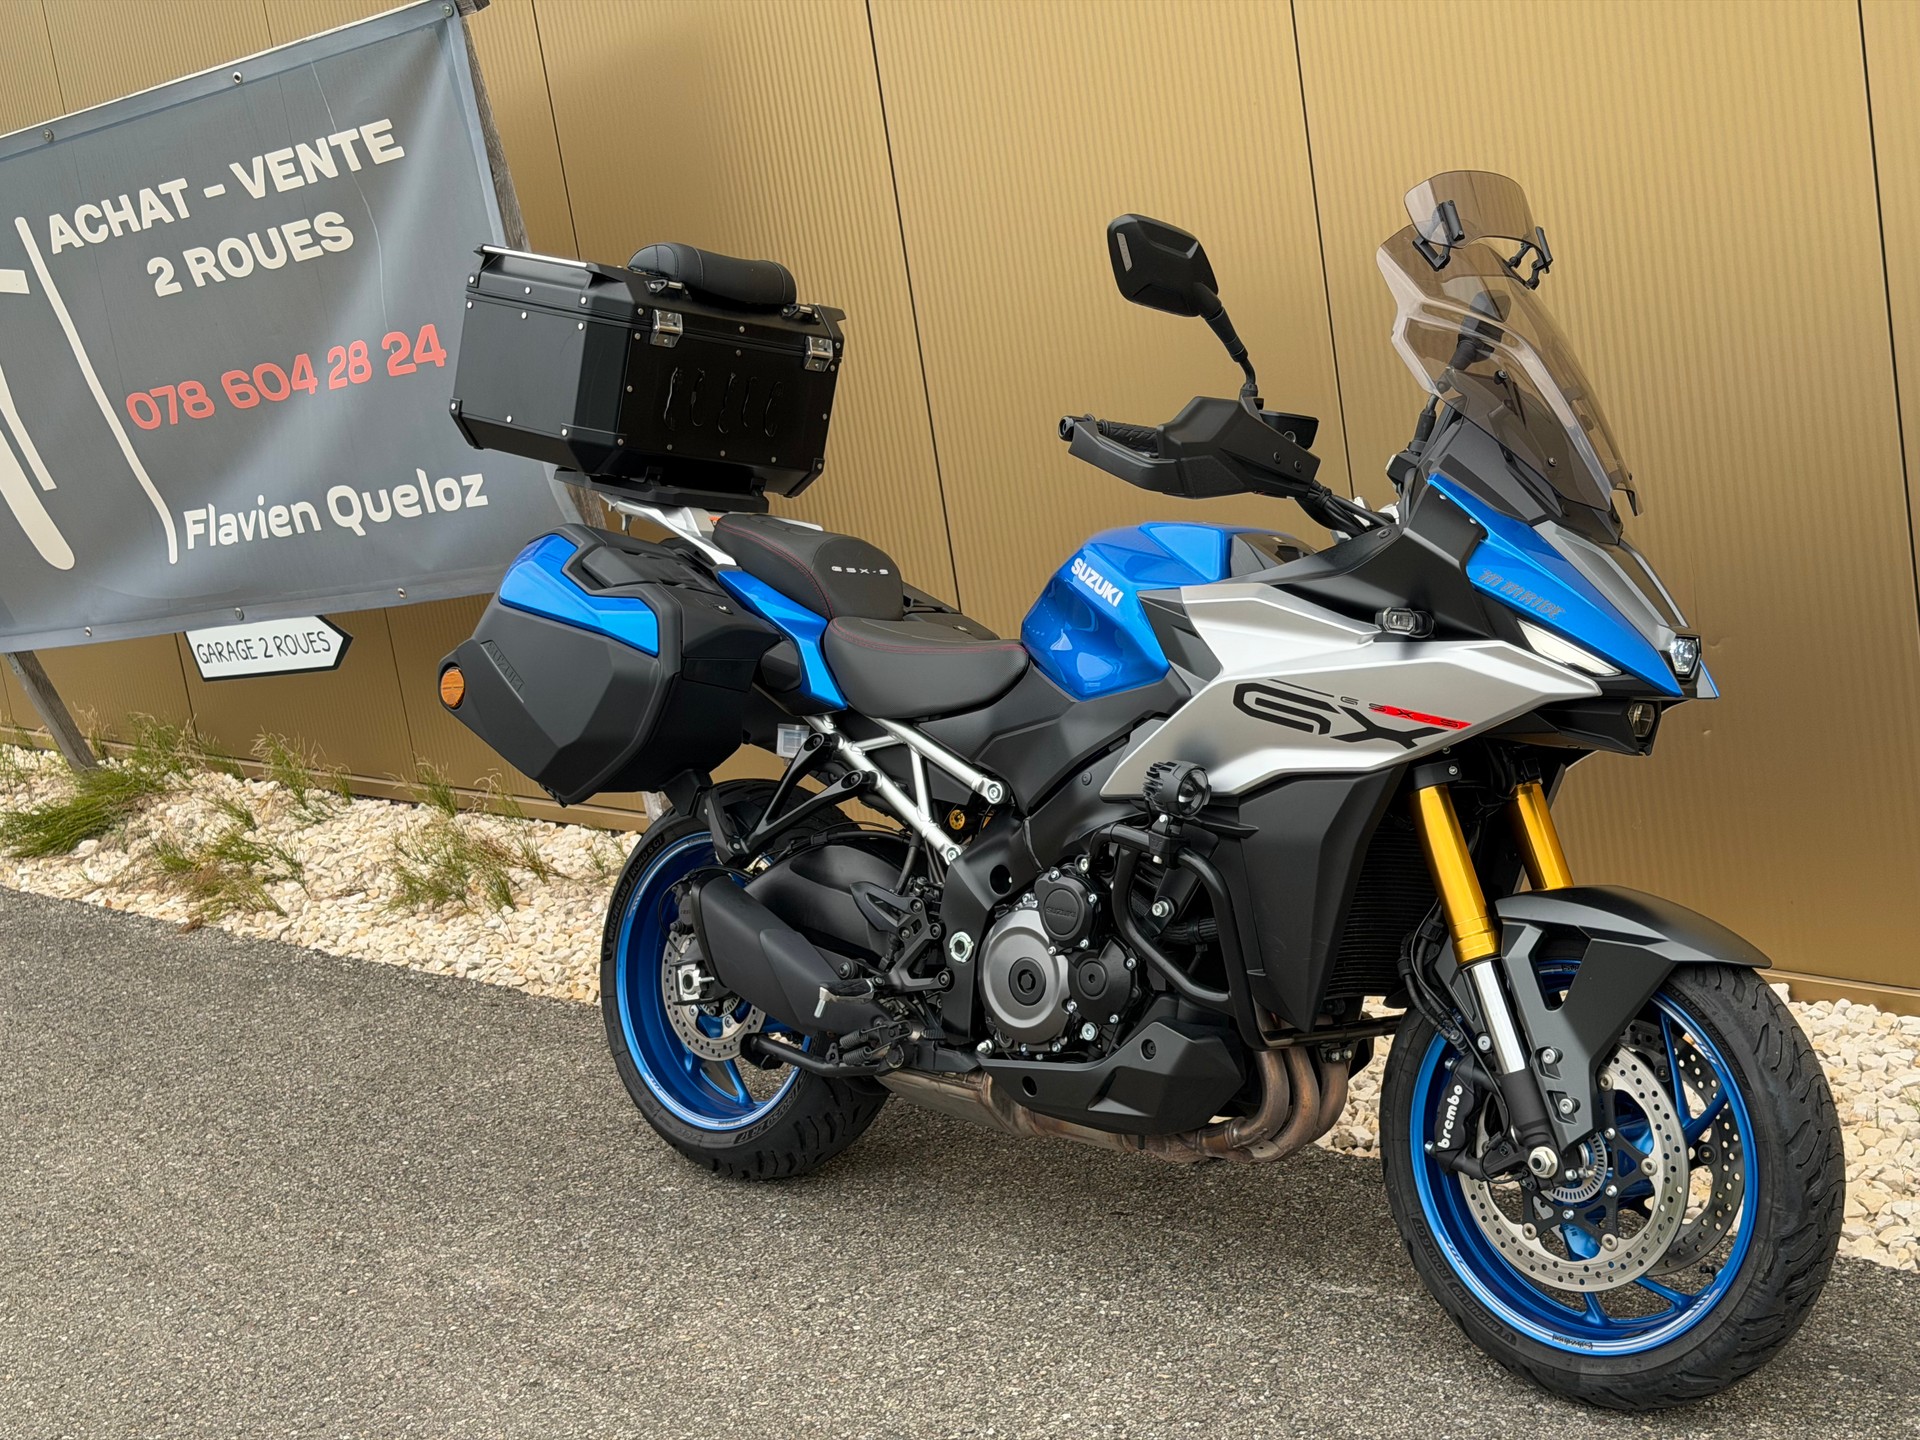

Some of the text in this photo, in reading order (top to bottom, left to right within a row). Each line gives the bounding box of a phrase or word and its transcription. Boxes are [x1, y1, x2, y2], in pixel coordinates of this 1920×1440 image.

[49, 178, 190, 255] ACHAT
[229, 118, 405, 199] VENTE
[147, 211, 354, 297] 2 ROUES
[126, 323, 447, 430] 078 604 28 24
[183, 468, 489, 550] Flavien Queloz
[831, 565, 889, 575] GSX-S
[1070, 557, 1125, 608] SUZUKI
[196, 630, 331, 664] GARAGE 2 ROUES
[607, 882, 629, 939] MICHELIN
[628, 851, 648, 876] ROAD
[1437, 1085, 1463, 1149] brembo
[1413, 1220, 1426, 1236] GT
[1427, 1246, 1449, 1278] ROAD
[1451, 1284, 1500, 1332] MICHELIN
